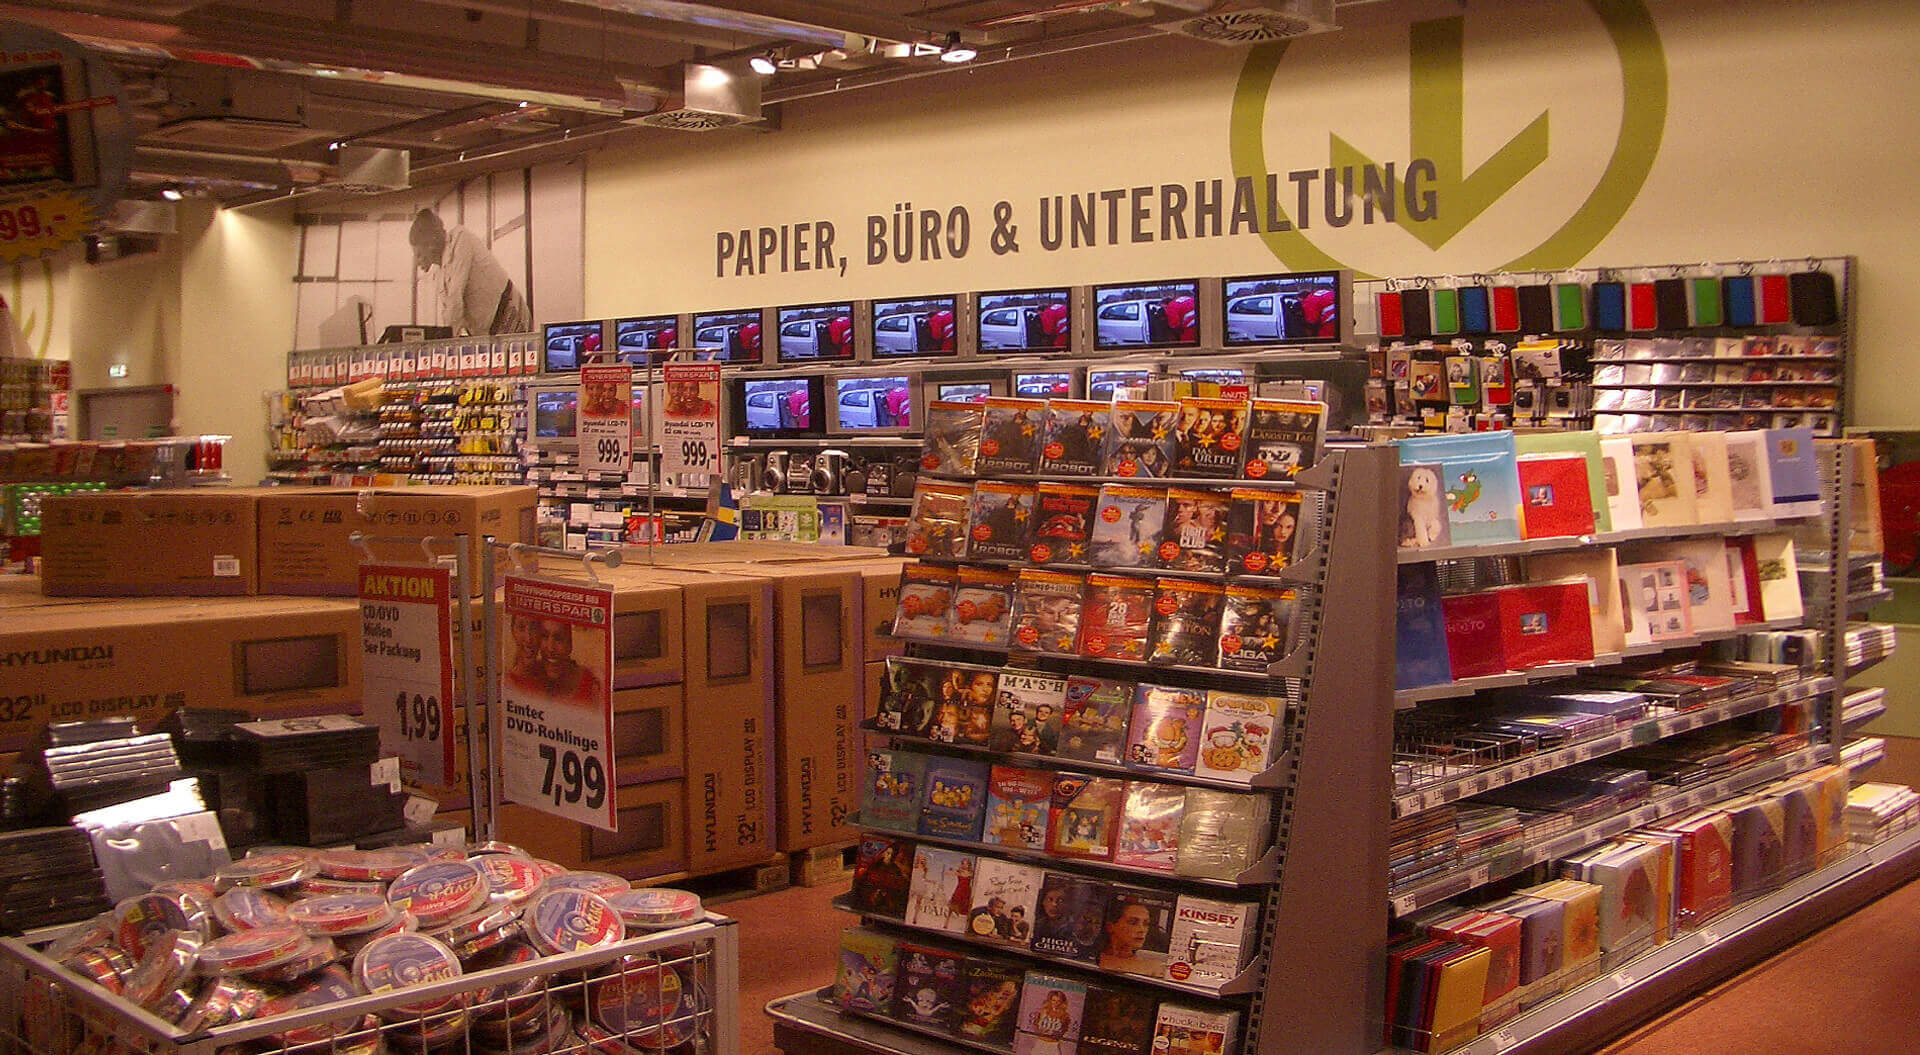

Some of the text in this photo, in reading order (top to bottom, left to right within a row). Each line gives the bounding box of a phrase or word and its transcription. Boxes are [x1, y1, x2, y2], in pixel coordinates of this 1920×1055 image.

[716, 158, 1439, 278] PAPIER, BÜRO & UNTERHALTUNG
[363, 574, 434, 599] AKTION
[516, 596, 591, 620] INTERSPAR
[0, 644, 114, 667] HYUNDAI
[51, 699, 82, 717] LCD
[88, 694, 157, 715] DISPLAY
[395, 690, 441, 742] 1,99
[506, 700, 545, 721] Emtec
[506, 716, 599, 752] DVD-Rohlinge
[834, 726, 847, 770] DISPLAY
[538, 743, 606, 810] 7,99
[743, 737, 757, 786] DISPLAY
[800, 756, 813, 835] HYUNDAI
[836, 771, 848, 795] LCD
[704, 772, 717, 853] HYUNDAI
[745, 787, 757, 811] LCD
[1178, 908, 1240, 925] KINSEY
